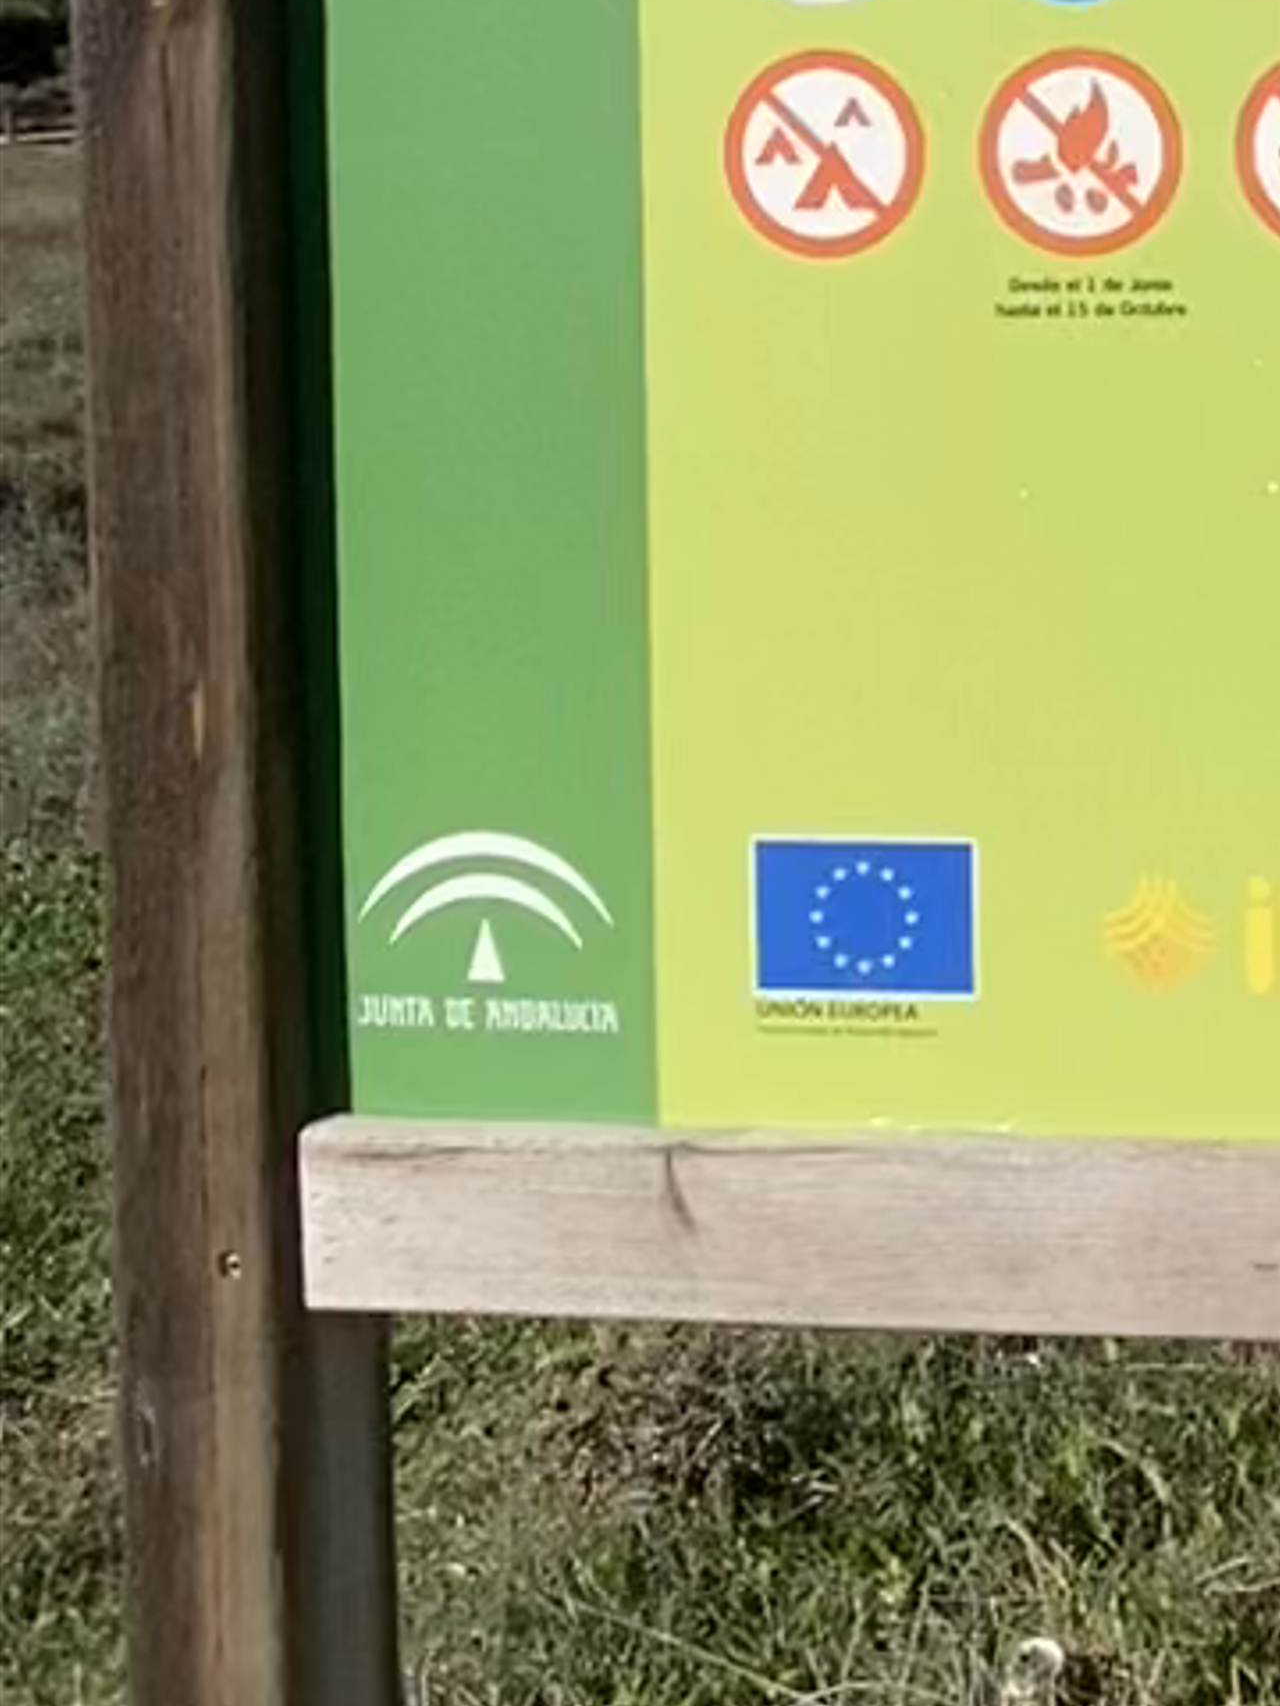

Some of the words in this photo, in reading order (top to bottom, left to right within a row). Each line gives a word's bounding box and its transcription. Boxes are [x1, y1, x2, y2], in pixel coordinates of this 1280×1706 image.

[358, 995, 434, 1027] JUNTA
[444, 997, 475, 1030] DE
[828, 1000, 919, 1022] EUROPEA
